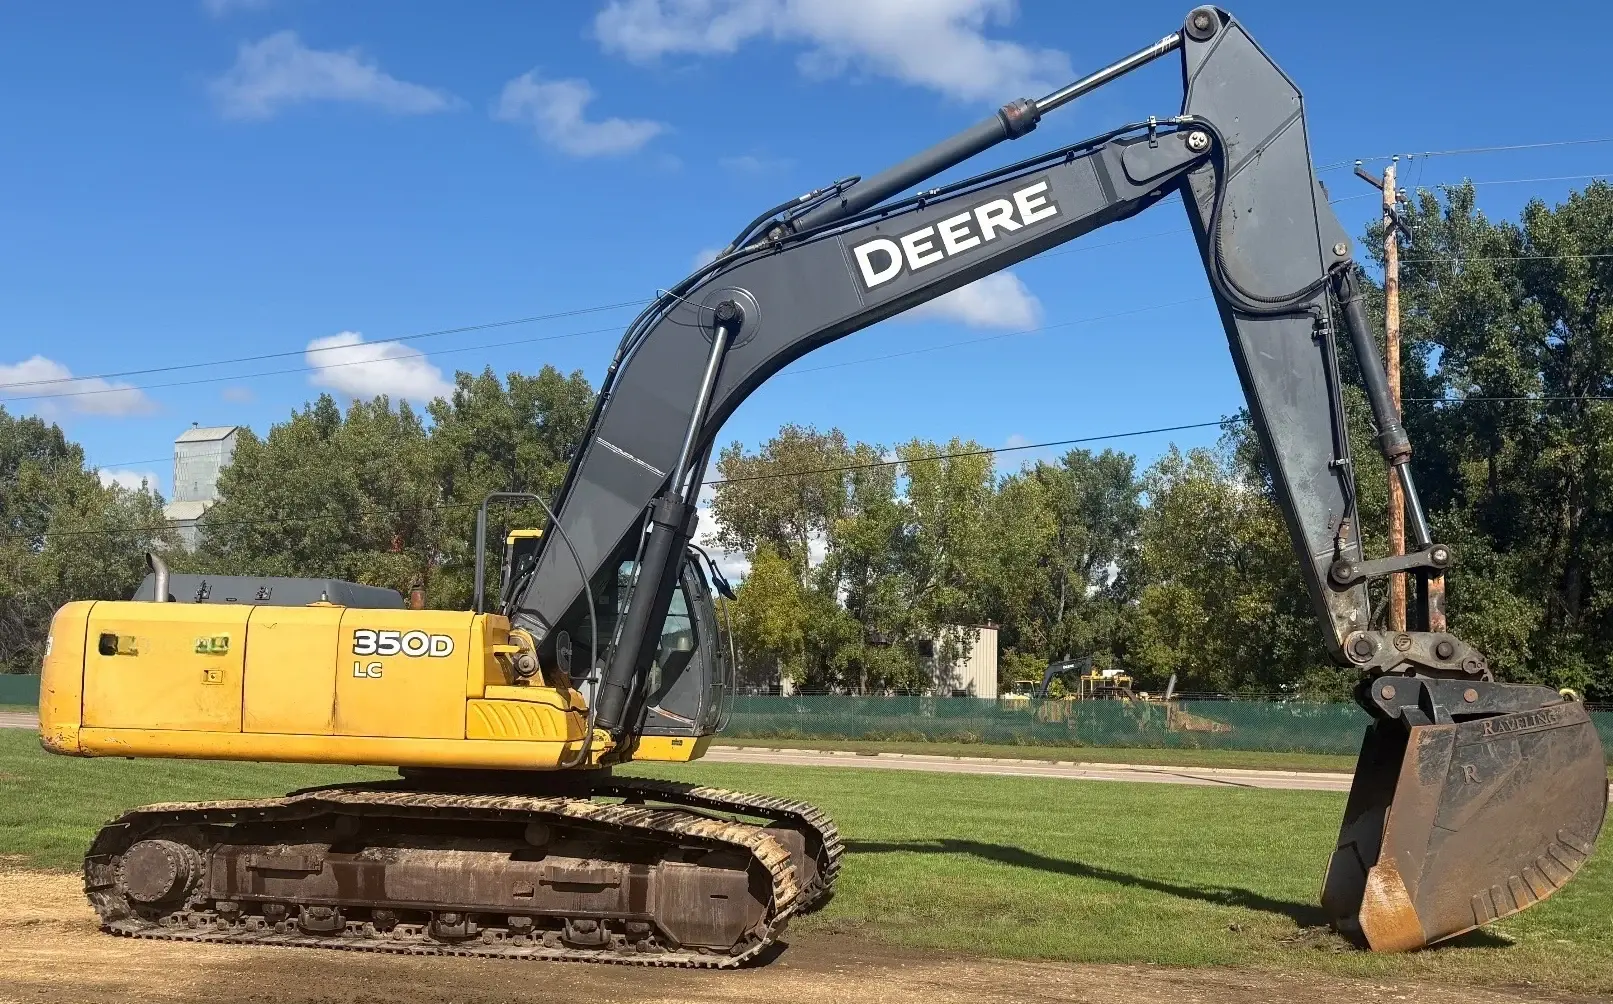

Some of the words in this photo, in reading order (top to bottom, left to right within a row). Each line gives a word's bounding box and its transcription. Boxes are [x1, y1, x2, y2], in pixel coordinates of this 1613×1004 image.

[853, 181, 1058, 288] DEERE
[352, 628, 455, 657] 350D
[353, 661, 382, 678] LC
[1481, 709, 1559, 737] RAVELING
[1460, 764, 1482, 785] R
